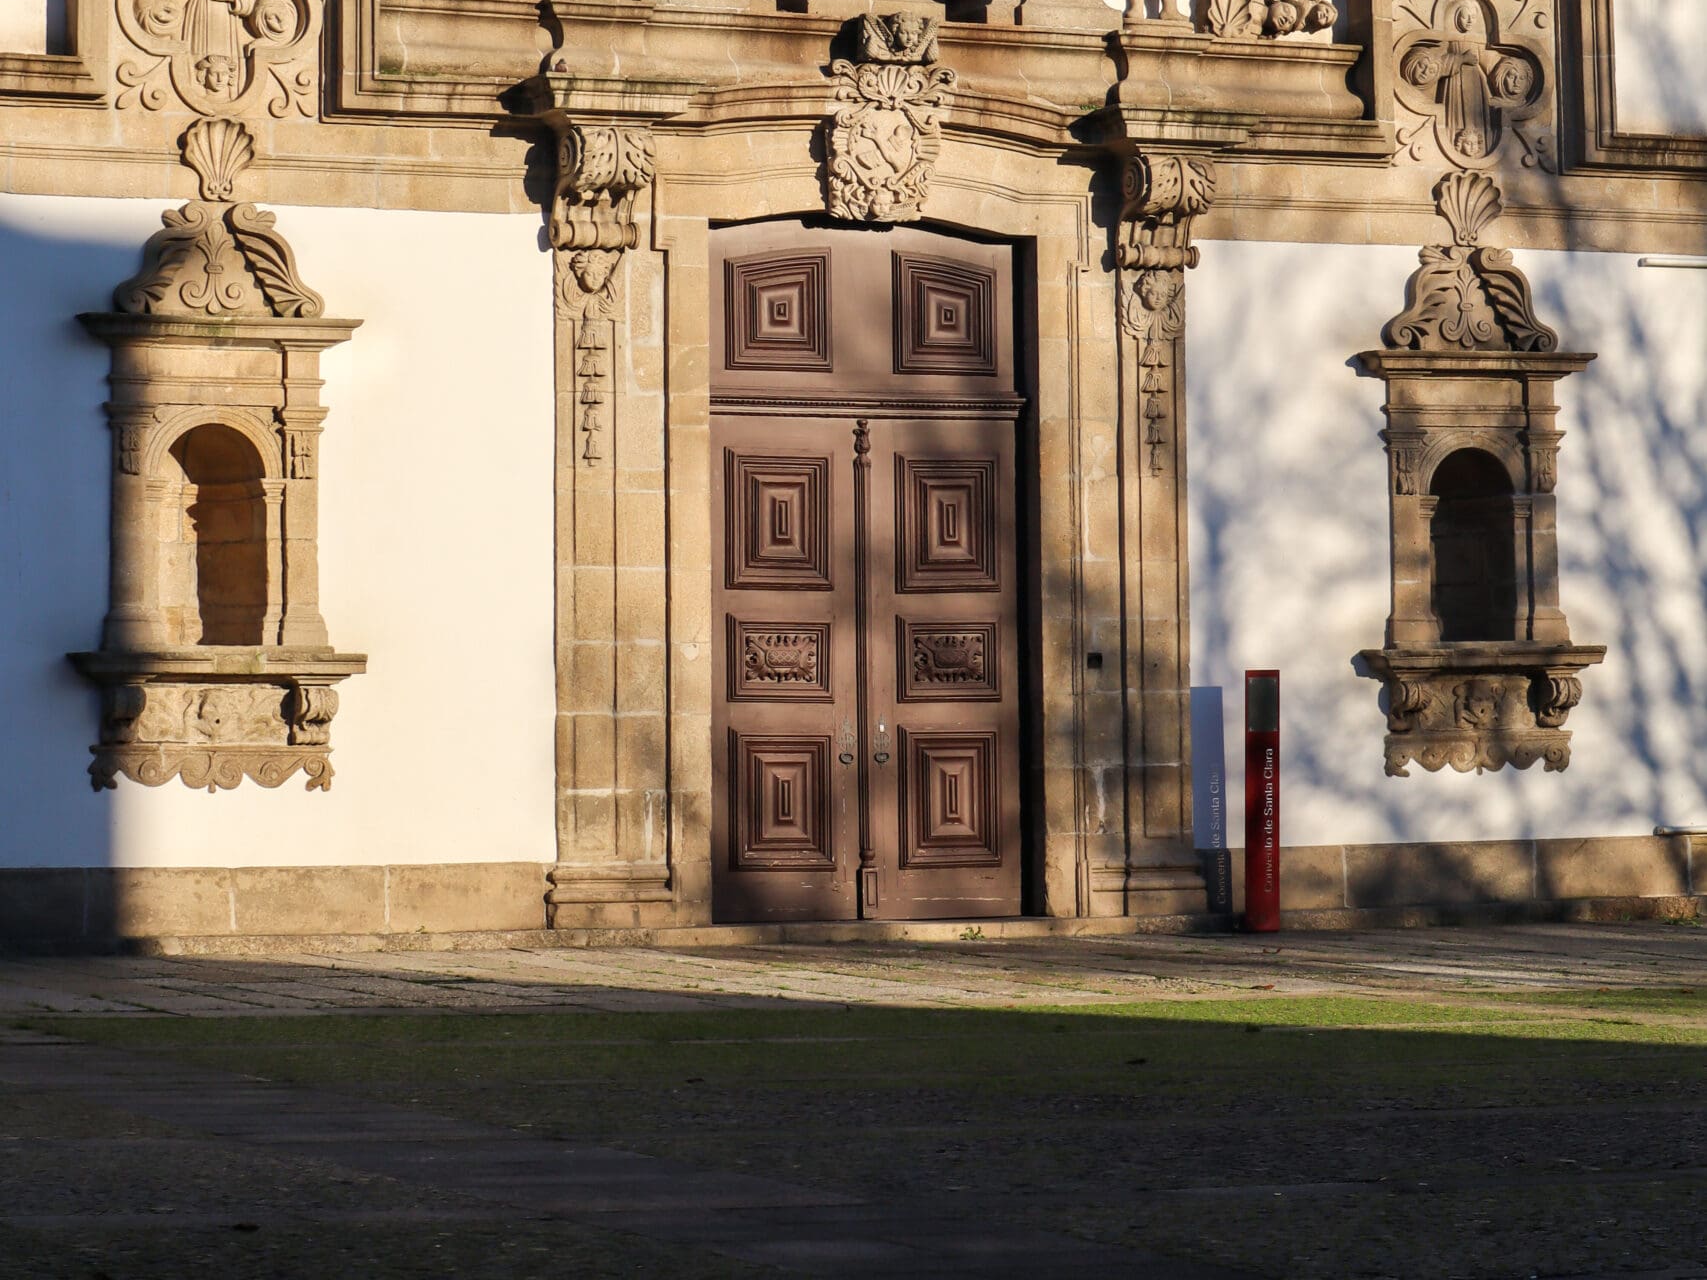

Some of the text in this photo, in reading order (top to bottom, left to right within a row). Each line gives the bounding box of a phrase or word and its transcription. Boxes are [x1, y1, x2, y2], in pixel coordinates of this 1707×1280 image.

[1263, 748, 1273, 893] Convento de Santa Clara
